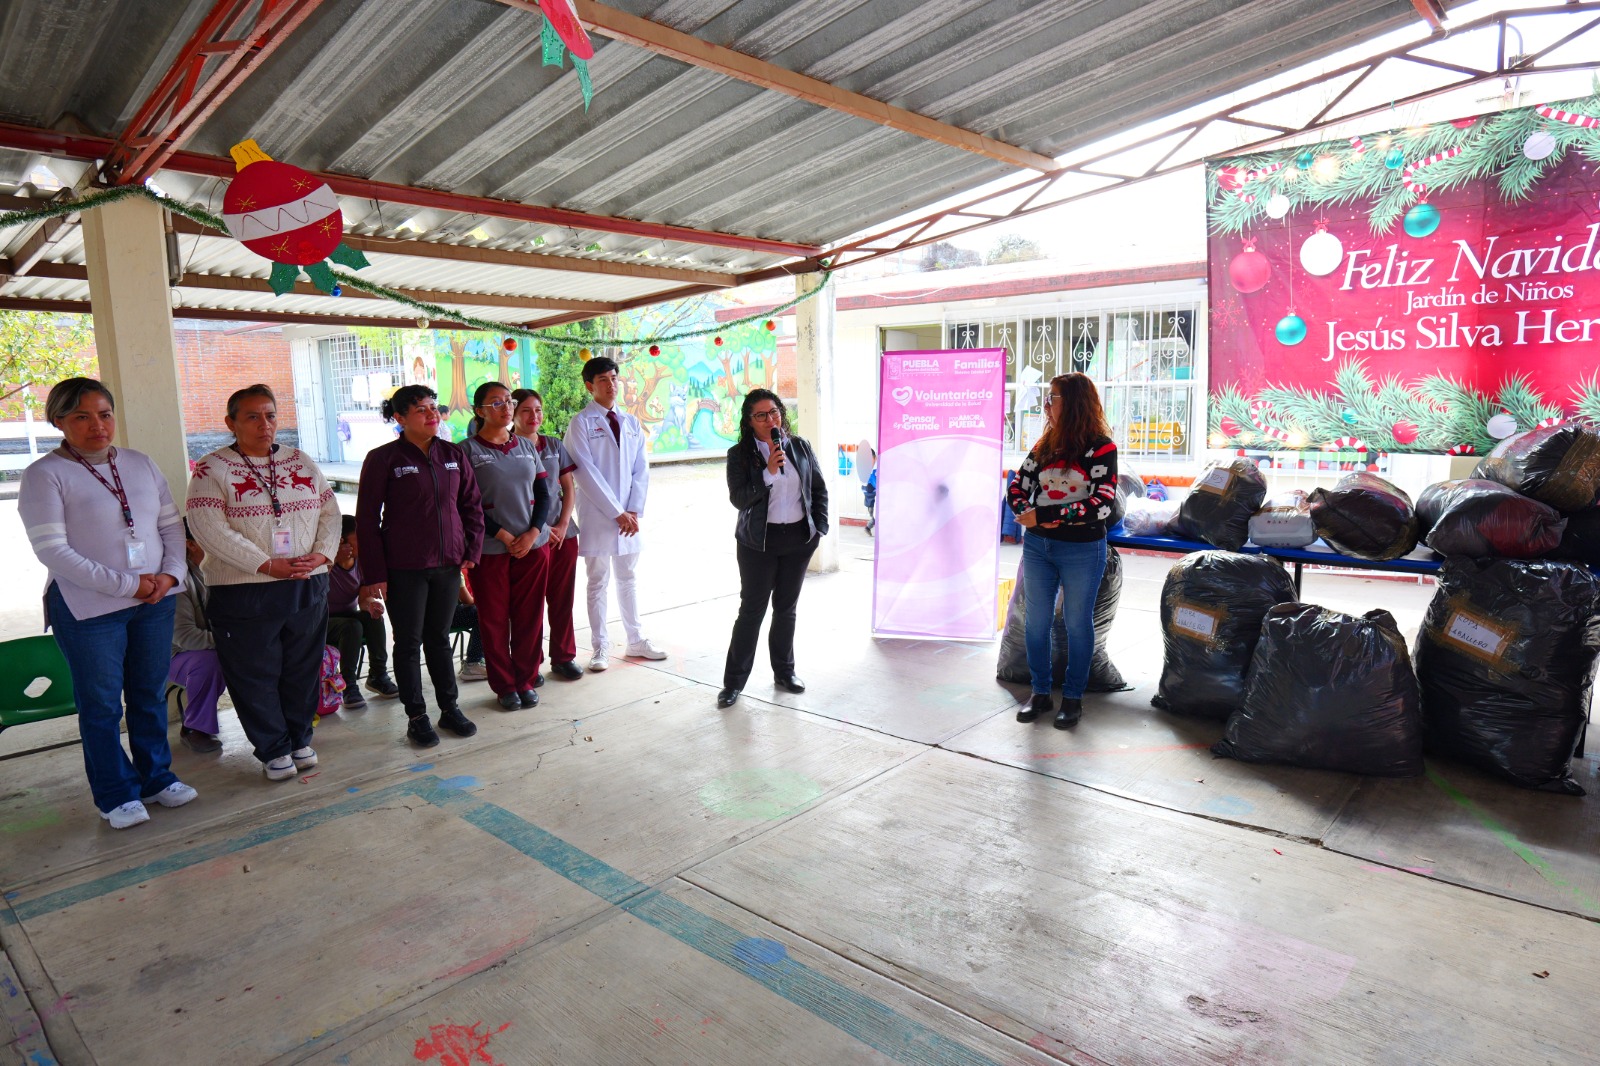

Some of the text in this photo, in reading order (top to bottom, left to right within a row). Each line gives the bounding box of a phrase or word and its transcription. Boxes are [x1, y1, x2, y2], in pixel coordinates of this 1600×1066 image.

[1339, 244, 1434, 290] Feliz
[1403, 281, 1575, 315] Jardín de Niños
[1321, 308, 1600, 362] Jesús Silva Her
[902, 359, 940, 369] PUEBLA
[954, 358, 1000, 370] Familias
[915, 389, 993, 401] Voluntariado
[902, 414, 936, 423] Pensar
[948, 420, 986, 429] PUEBLA
[903, 422, 940, 430] Grande
